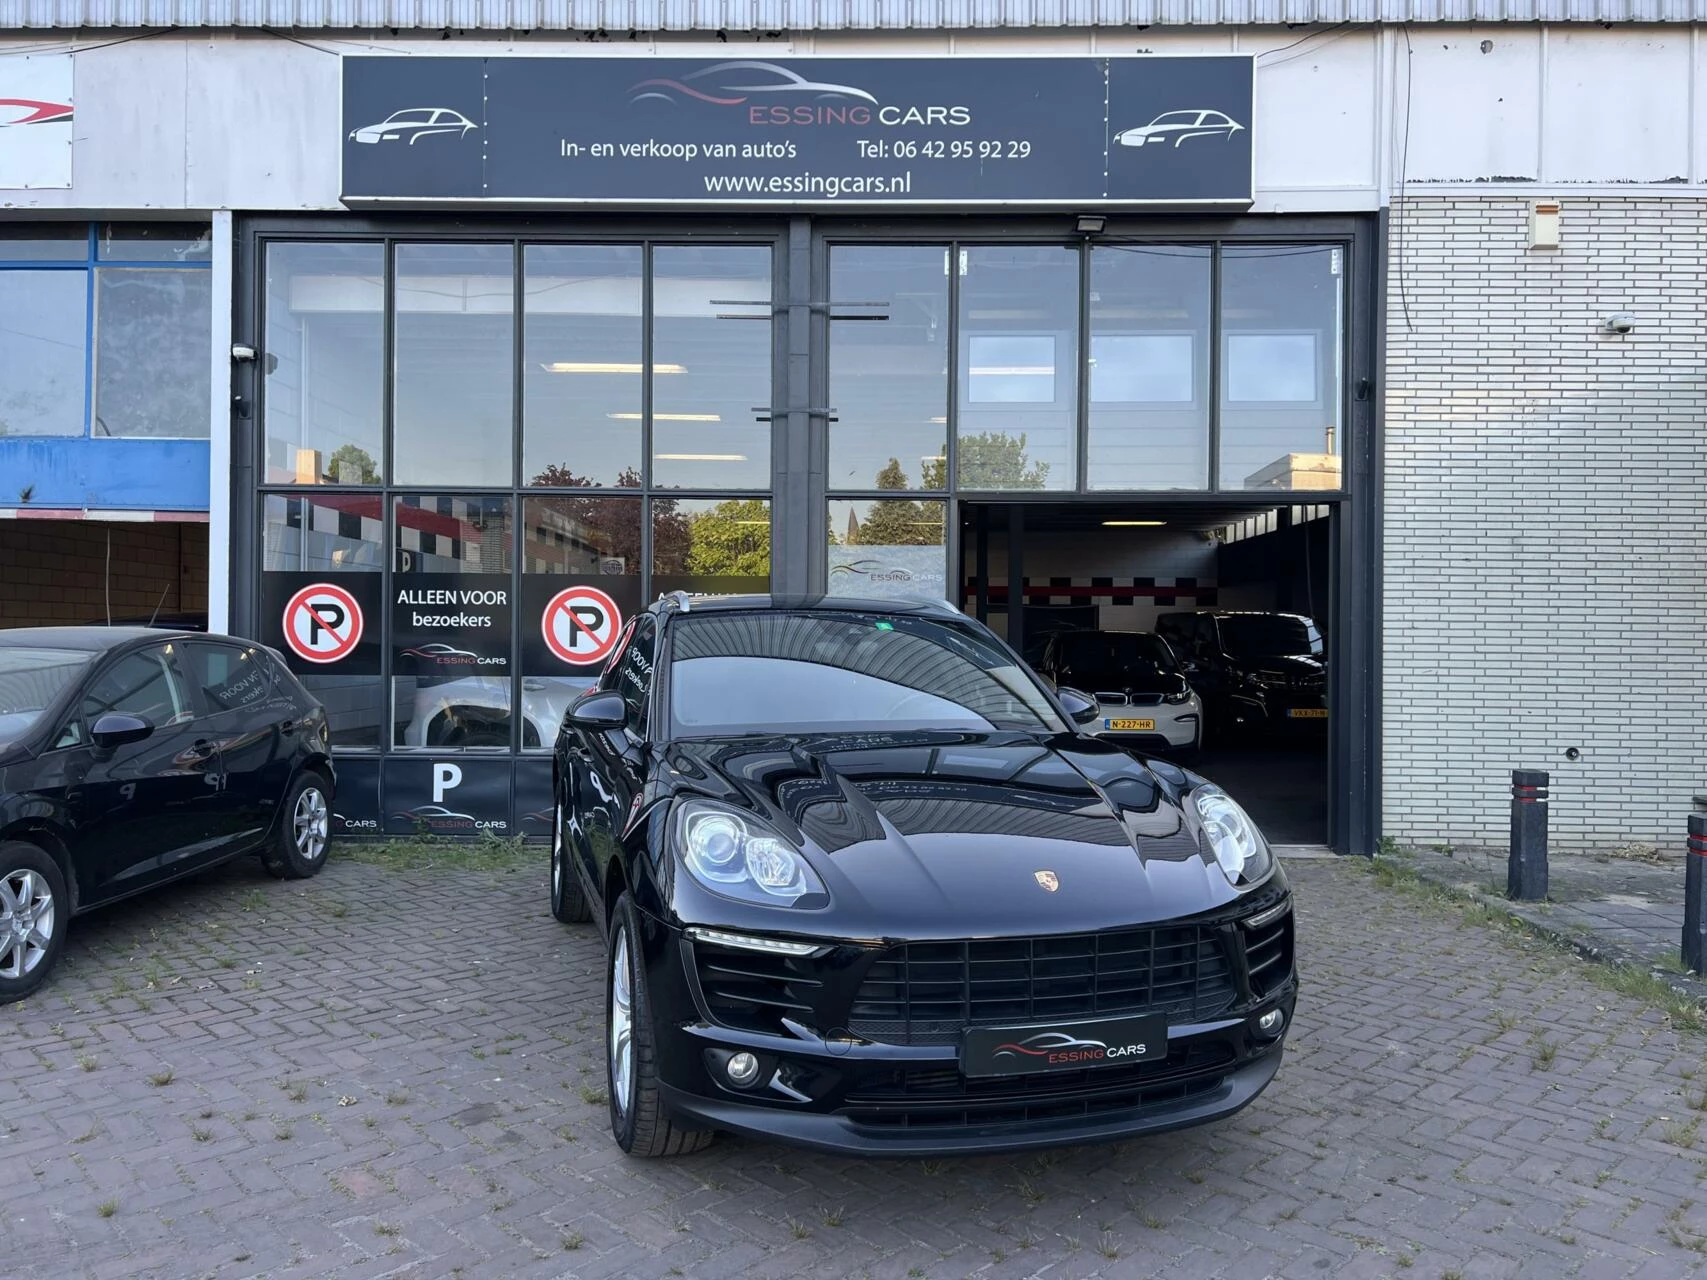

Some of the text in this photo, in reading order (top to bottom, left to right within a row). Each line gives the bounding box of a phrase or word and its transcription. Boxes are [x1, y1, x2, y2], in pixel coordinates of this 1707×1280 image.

[748, 106, 971, 126] ESSING CARS
[560, 139, 586, 157] In-
[590, 143, 614, 157] en
[619, 139, 698, 162] verkoop
[702, 143, 737, 158] van
[856, 140, 1031, 159] Tel: 06 42 95 92 29
[703, 171, 912, 198] www.essingcars.nl
[912, 574, 943, 582] CARS
[397, 590, 507, 606] ALLEEN VOOR
[412, 611, 492, 628] bezoekers
[436, 657, 507, 665] ESSING CARS
[1112, 720, 1151, 729] N-227-HR
[432, 763, 463, 803] P
[345, 820, 377, 829] CARS
[474, 820, 507, 829] CARS
[1048, 1043, 1146, 1064] ESSING CARS
